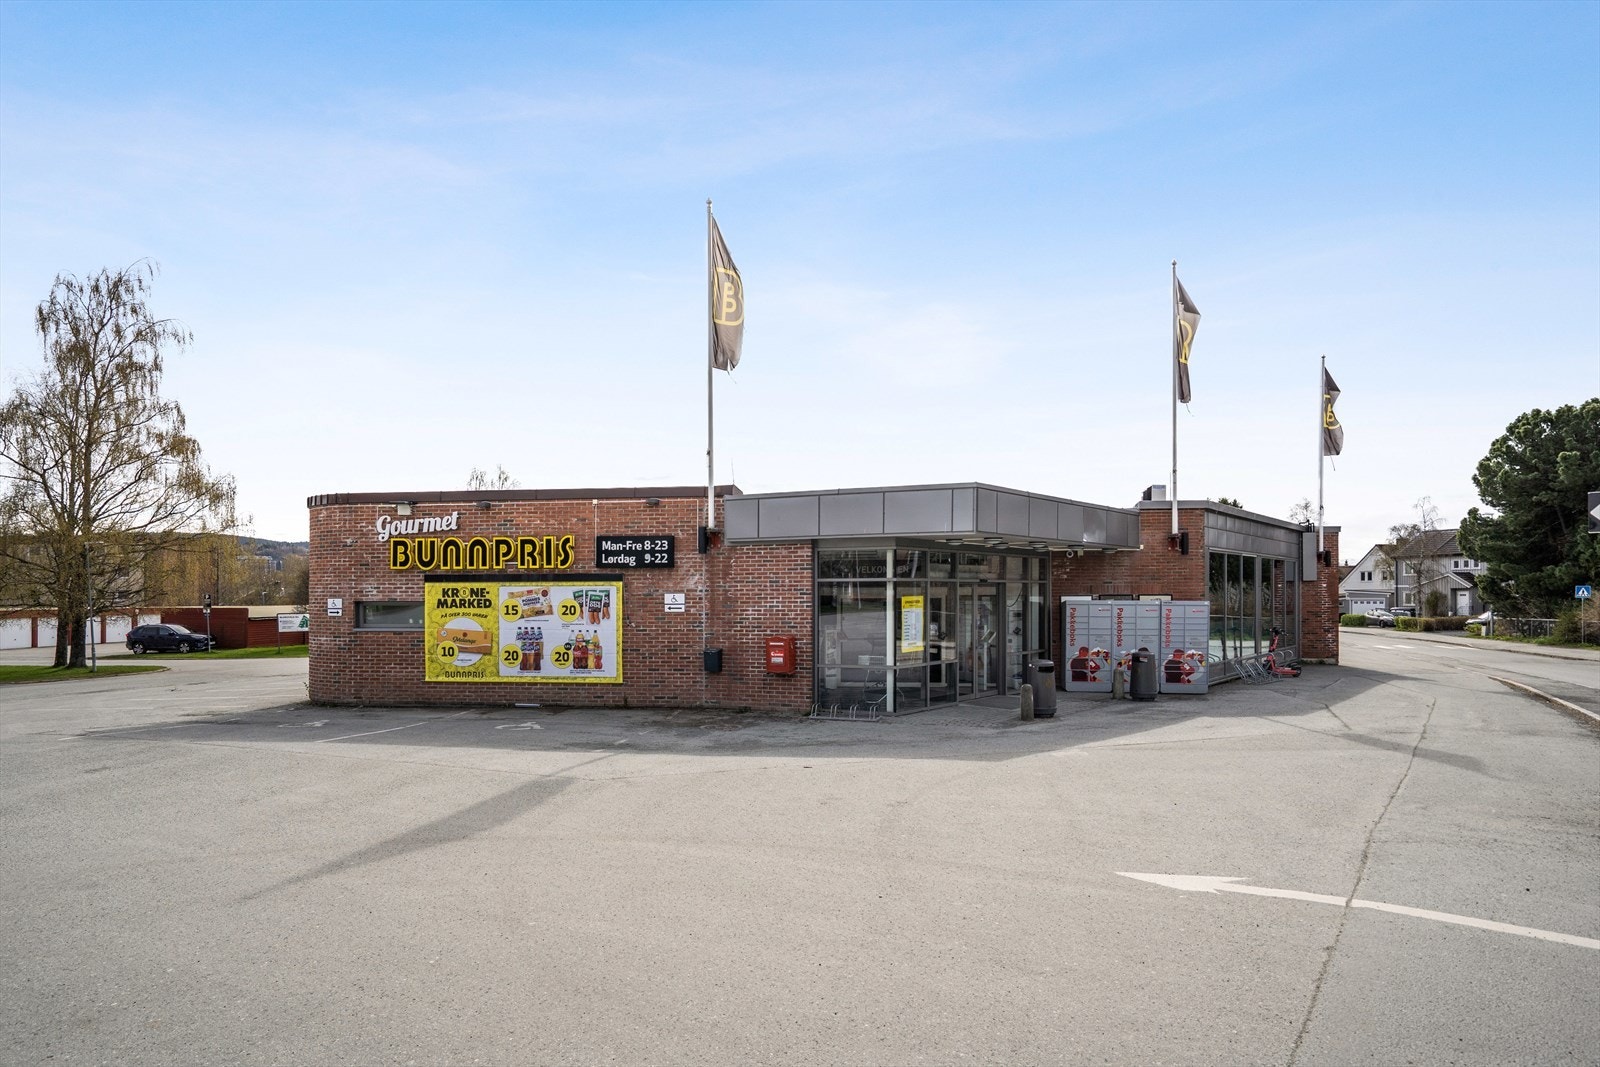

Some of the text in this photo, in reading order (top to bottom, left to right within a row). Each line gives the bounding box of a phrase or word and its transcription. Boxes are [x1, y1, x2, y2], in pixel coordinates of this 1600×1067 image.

[376, 511, 460, 542] Gourmet
[602, 540, 668, 551] Man-Fre 8-23
[390, 535, 575, 571] BUNNPRIS
[602, 553, 668, 567] Lørdag 9-22
[436, 598, 492, 609] MARKED
[504, 605, 518, 615] 15
[561, 605, 576, 615] 20
[1069, 607, 1077, 646] Pakkeboks
[1116, 607, 1124, 647] Pakkeboks
[1164, 608, 1172, 649] Pakkeboks
[441, 646, 455, 657] 10
[504, 650, 519, 661] 20
[554, 651, 570, 662] 20
[444, 670, 485, 678] BUNNPRIS
